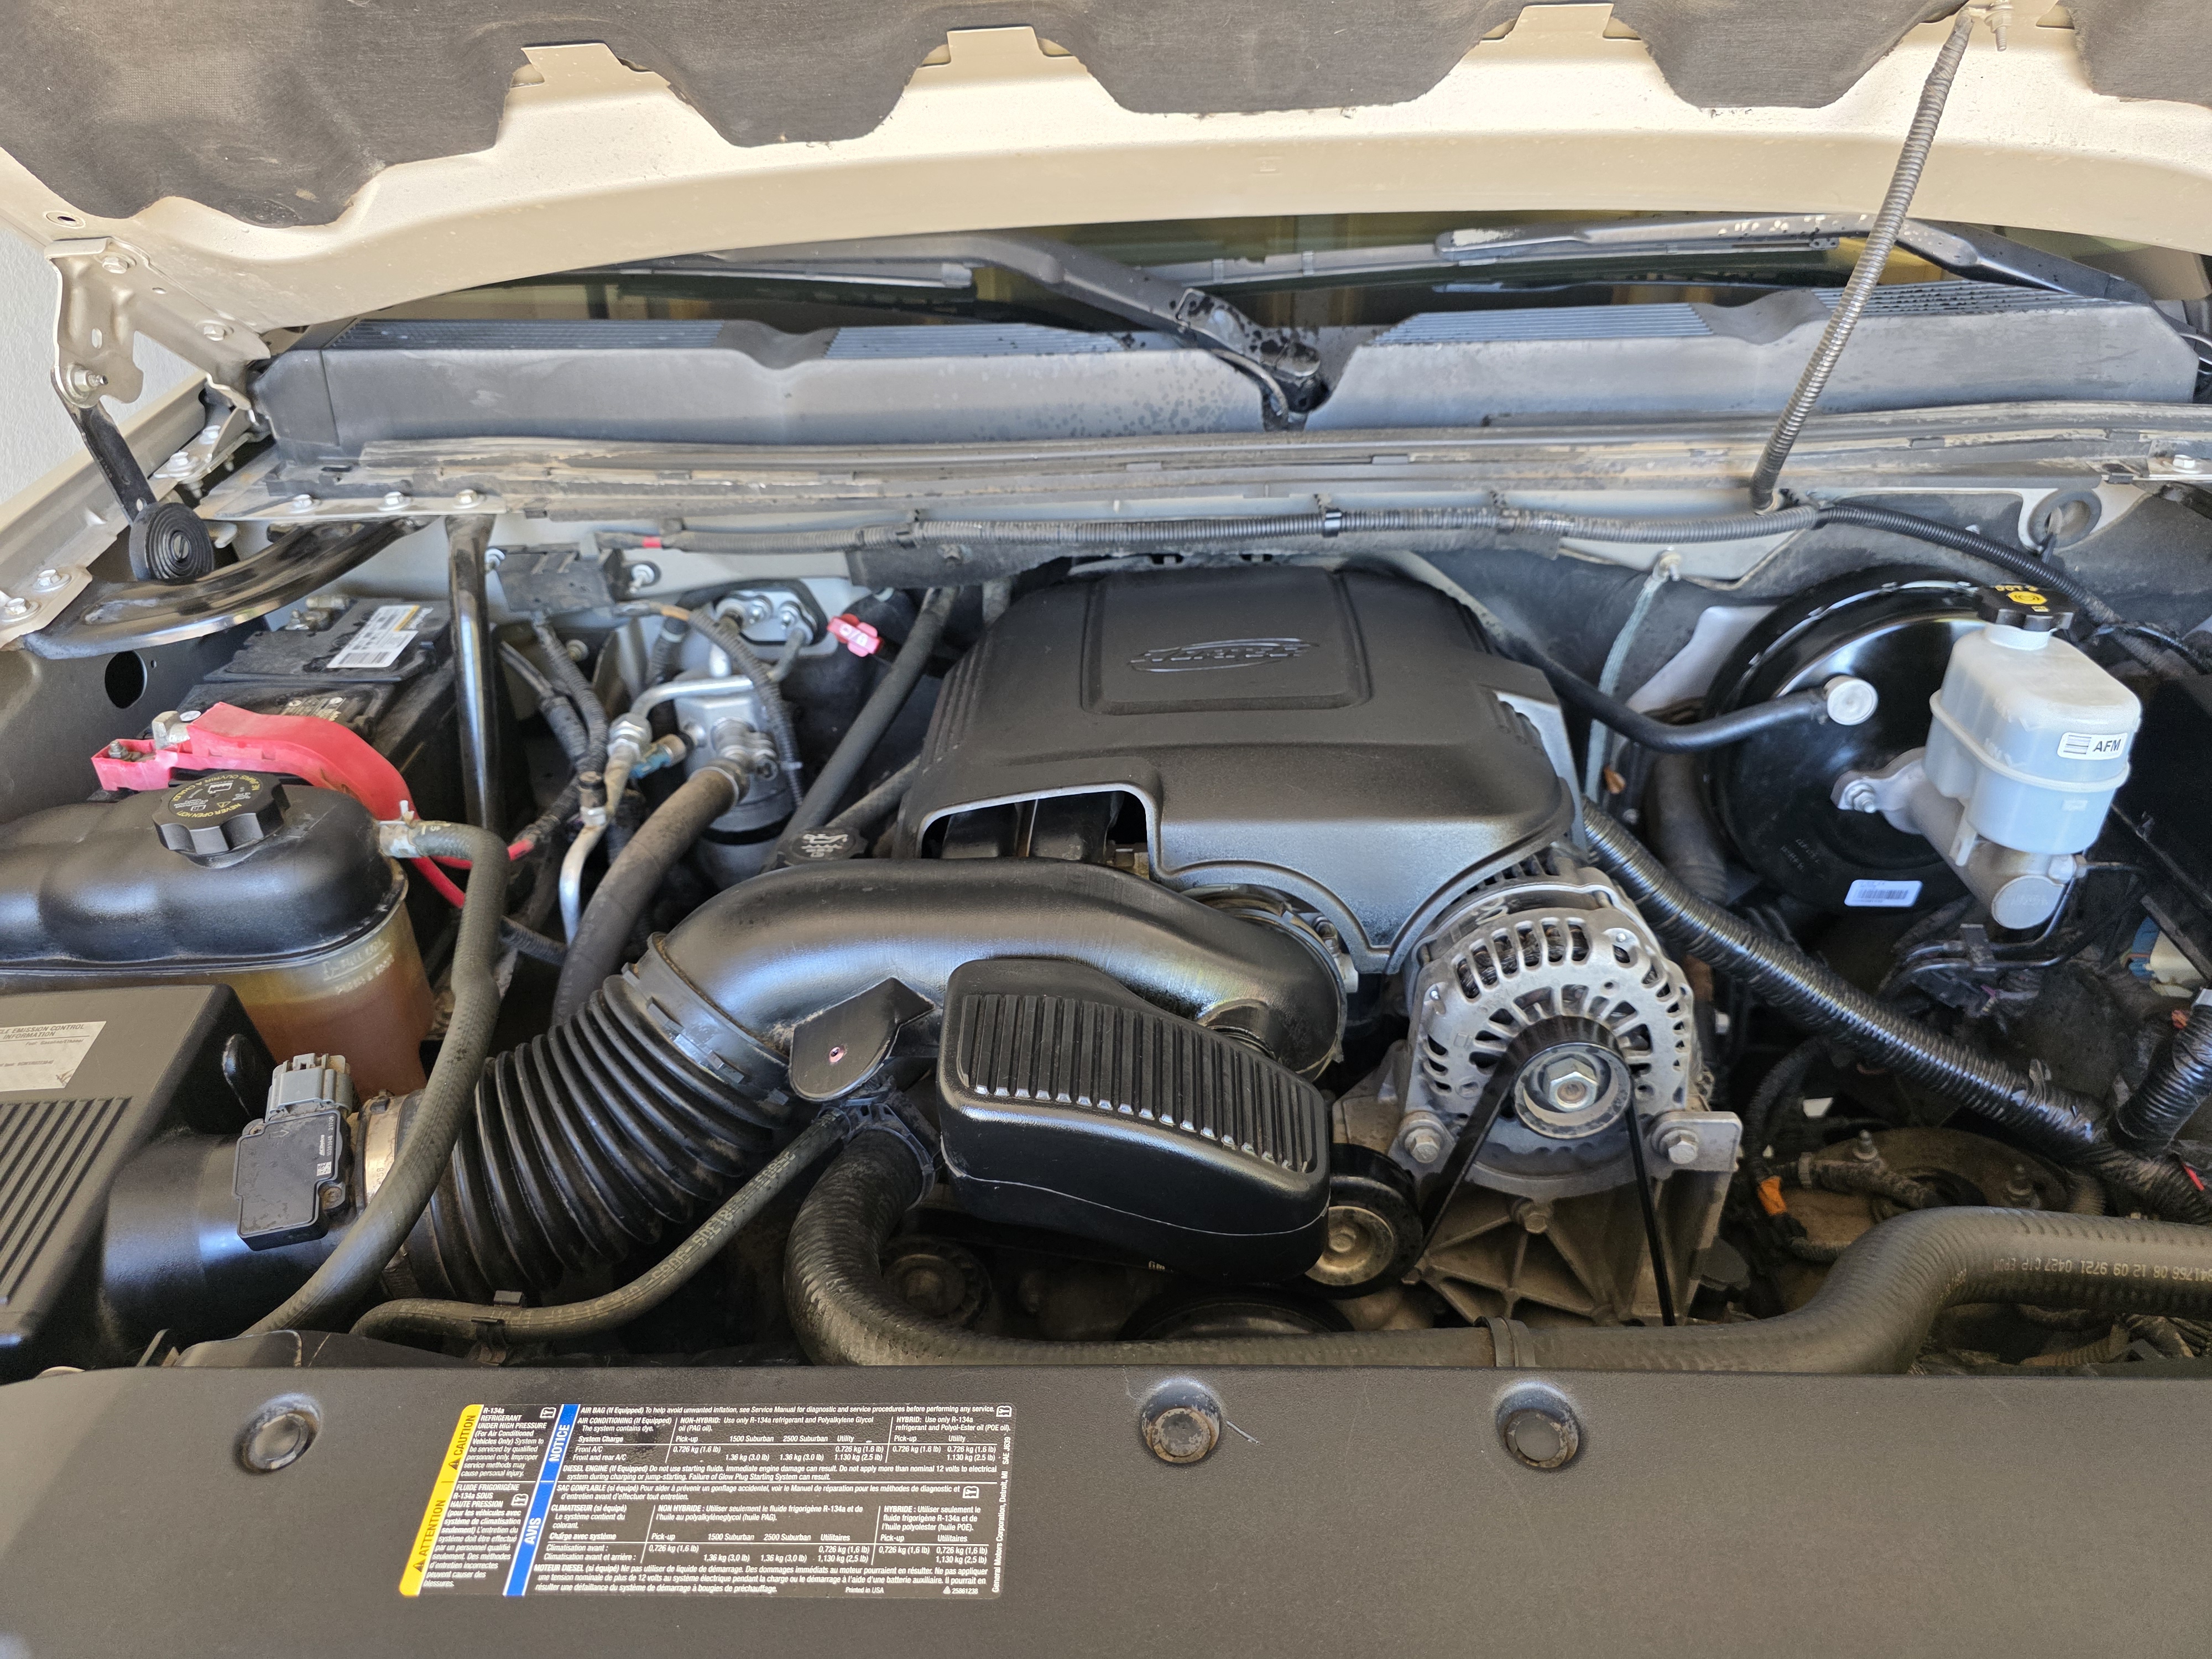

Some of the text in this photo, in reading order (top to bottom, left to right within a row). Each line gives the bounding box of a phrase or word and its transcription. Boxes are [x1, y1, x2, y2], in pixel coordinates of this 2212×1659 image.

[2093, 739, 2122, 752] AFM
[205, 775, 239, 783] OUVRIR
[215, 803, 242, 816] NEVER
[3, 1031, 56, 1040] INFORMATION
[2044, 1258, 2072, 1272] 0427
[2080, 1259, 2107, 1276] 9721
[2114, 1262, 2129, 1276] 09
[2133, 1263, 2146, 1278] 12
[937, 1416, 951, 1424] only
[453, 1415, 476, 1455] CAUTION
[948, 1434, 966, 1443] Utility
[549, 1424, 570, 1462] NOTICE
[1003, 1436, 1011, 1451] J639
[739, 1453, 748, 1462] kg
[748, 1453, 761, 1462] (3.0
[761, 1453, 770, 1462] lb)
[1000, 1470, 1009, 1479] MI
[478, 1482, 520, 1490] FRIGORIGÈNE
[607, 1484, 615, 1493] (si
[615, 1484, 639, 1493] équipé)
[999, 1479, 1009, 1503] Detroit,
[593, 1504, 603, 1512] (si
[602, 1504, 627, 1512] équipé)
[419, 1500, 446, 1557] ATTENTION
[996, 1503, 1007, 1542] Corporation,
[524, 1517, 541, 1545] AVIS
[936, 1556, 987, 1564] 1,130 kg (2,5 lb)
[994, 1542, 1003, 1566] Motors
[992, 1567, 1001, 1593] General
